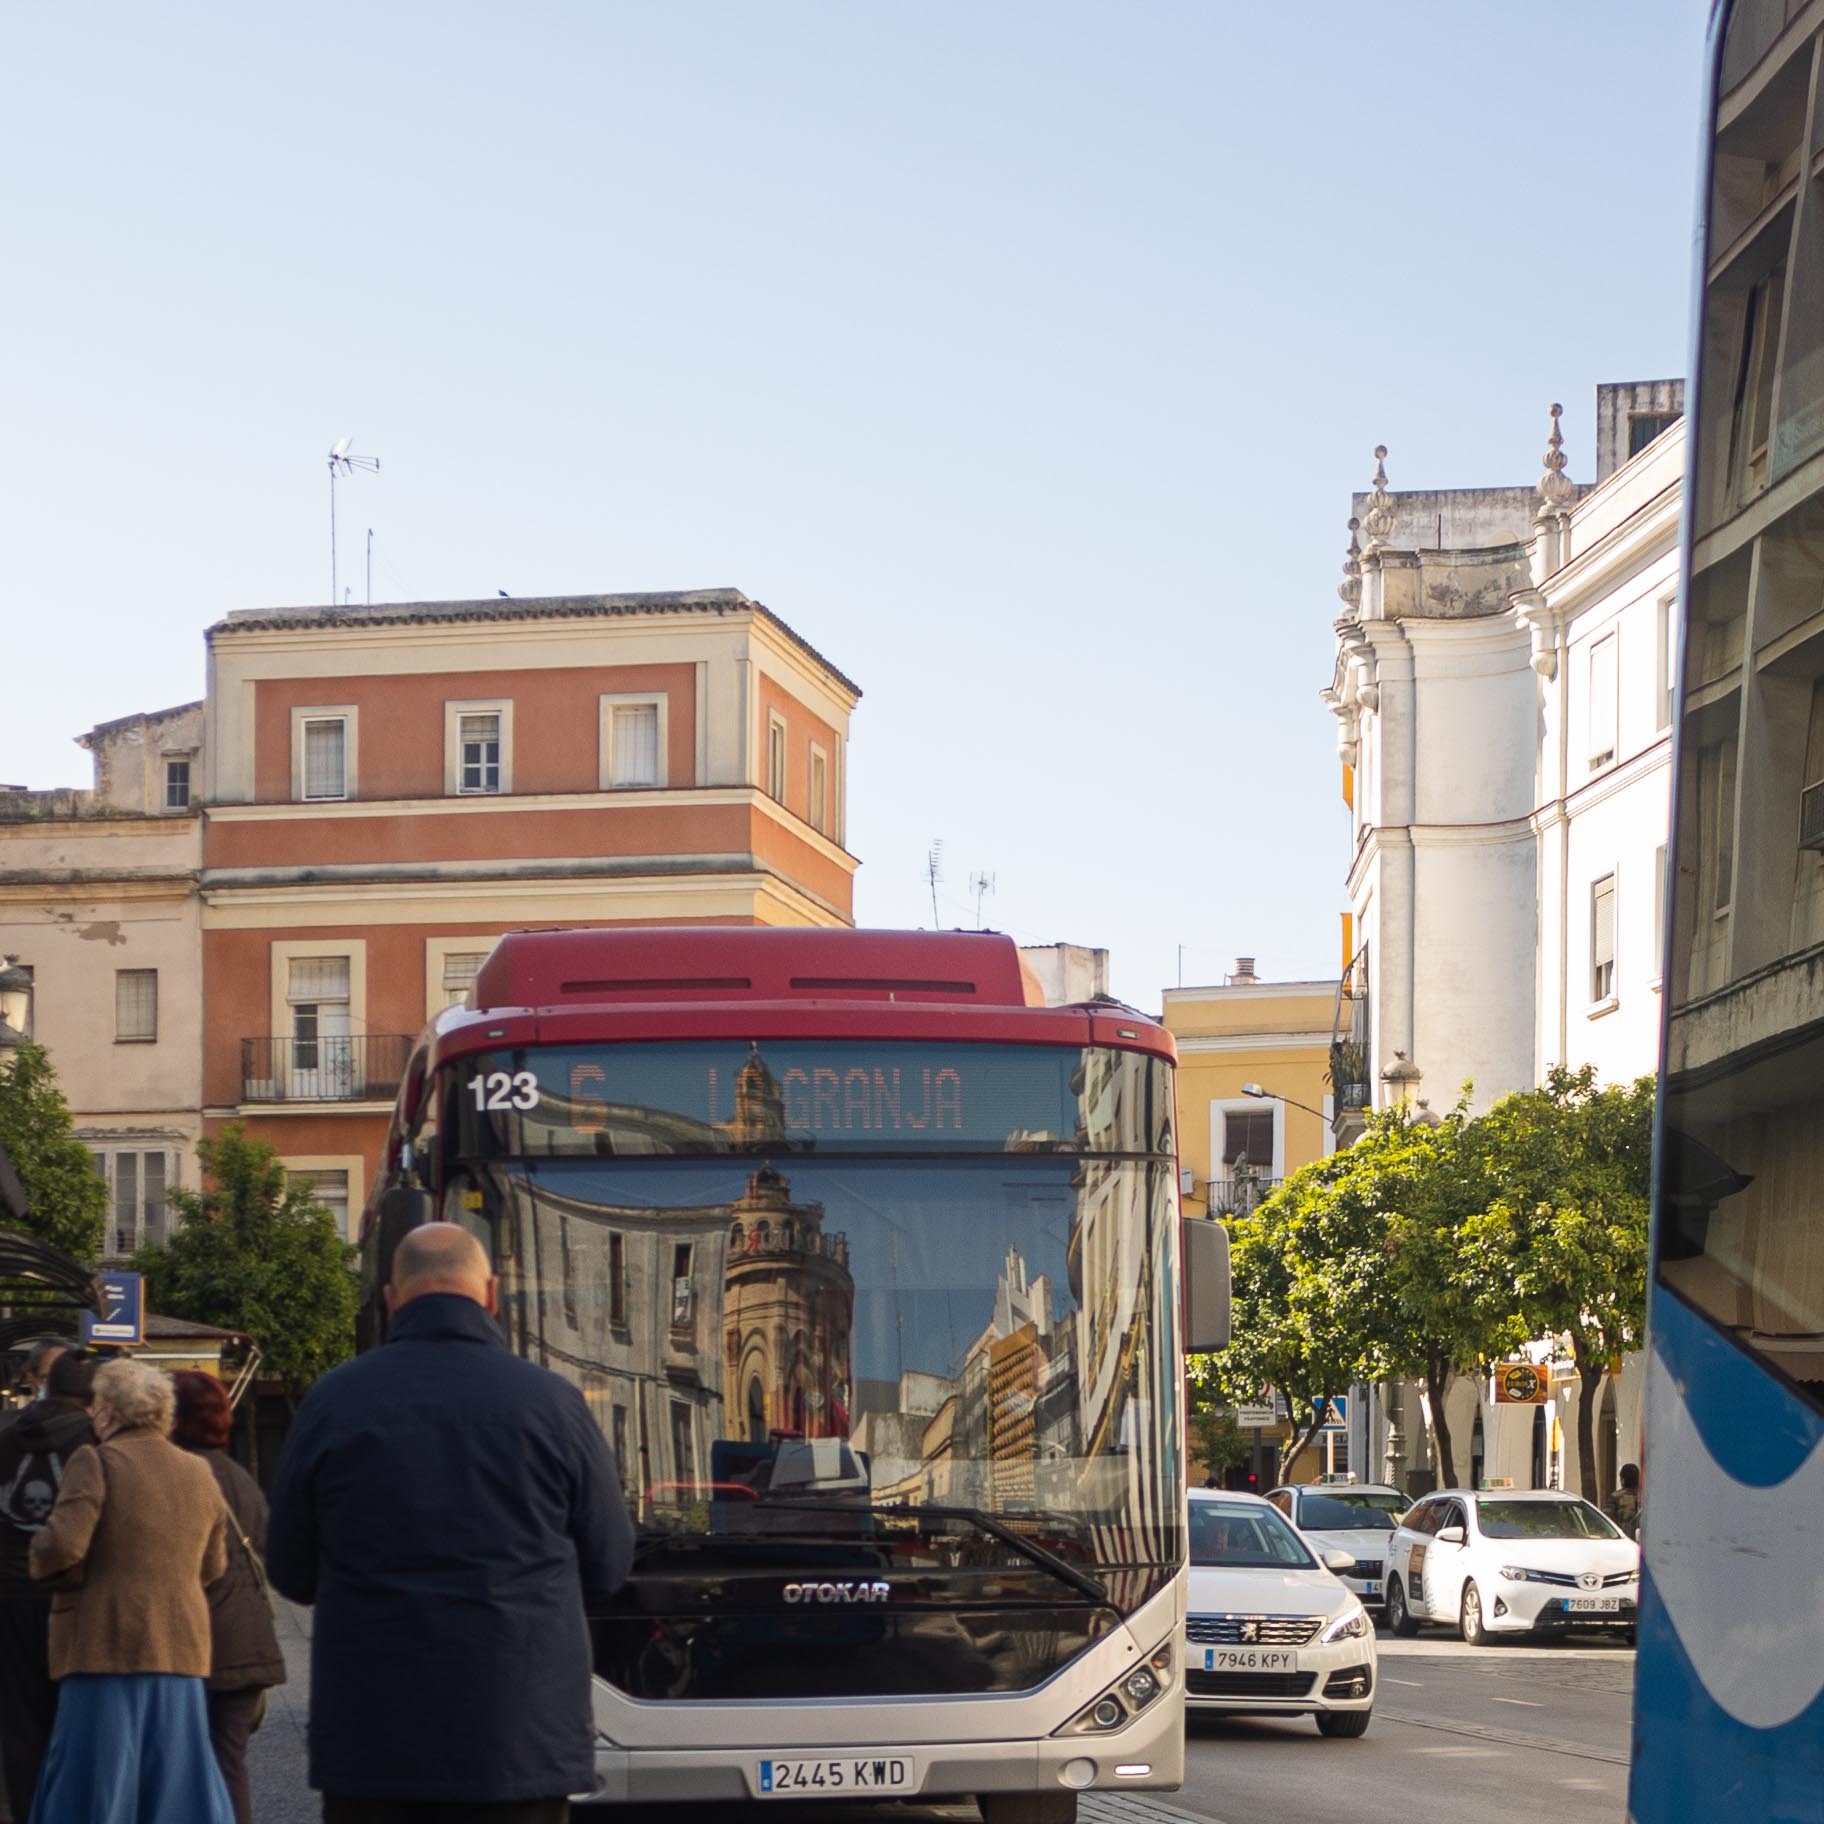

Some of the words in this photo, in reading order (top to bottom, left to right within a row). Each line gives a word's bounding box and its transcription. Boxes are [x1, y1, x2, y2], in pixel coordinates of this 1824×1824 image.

[467, 1072, 539, 1112] 123
[570, 1065, 607, 1135] 6
[784, 1067, 962, 1130] GRANJA
[783, 1582, 891, 1604] OTOKAR
[1569, 1599, 1596, 1611] 7609
[1598, 1599, 1618, 1611] JBZ
[1218, 1653, 1256, 1668] 7946
[1261, 1653, 1290, 1668] KPY
[776, 1762, 843, 1788] 2445
[854, 1760, 905, 1786] KWD
